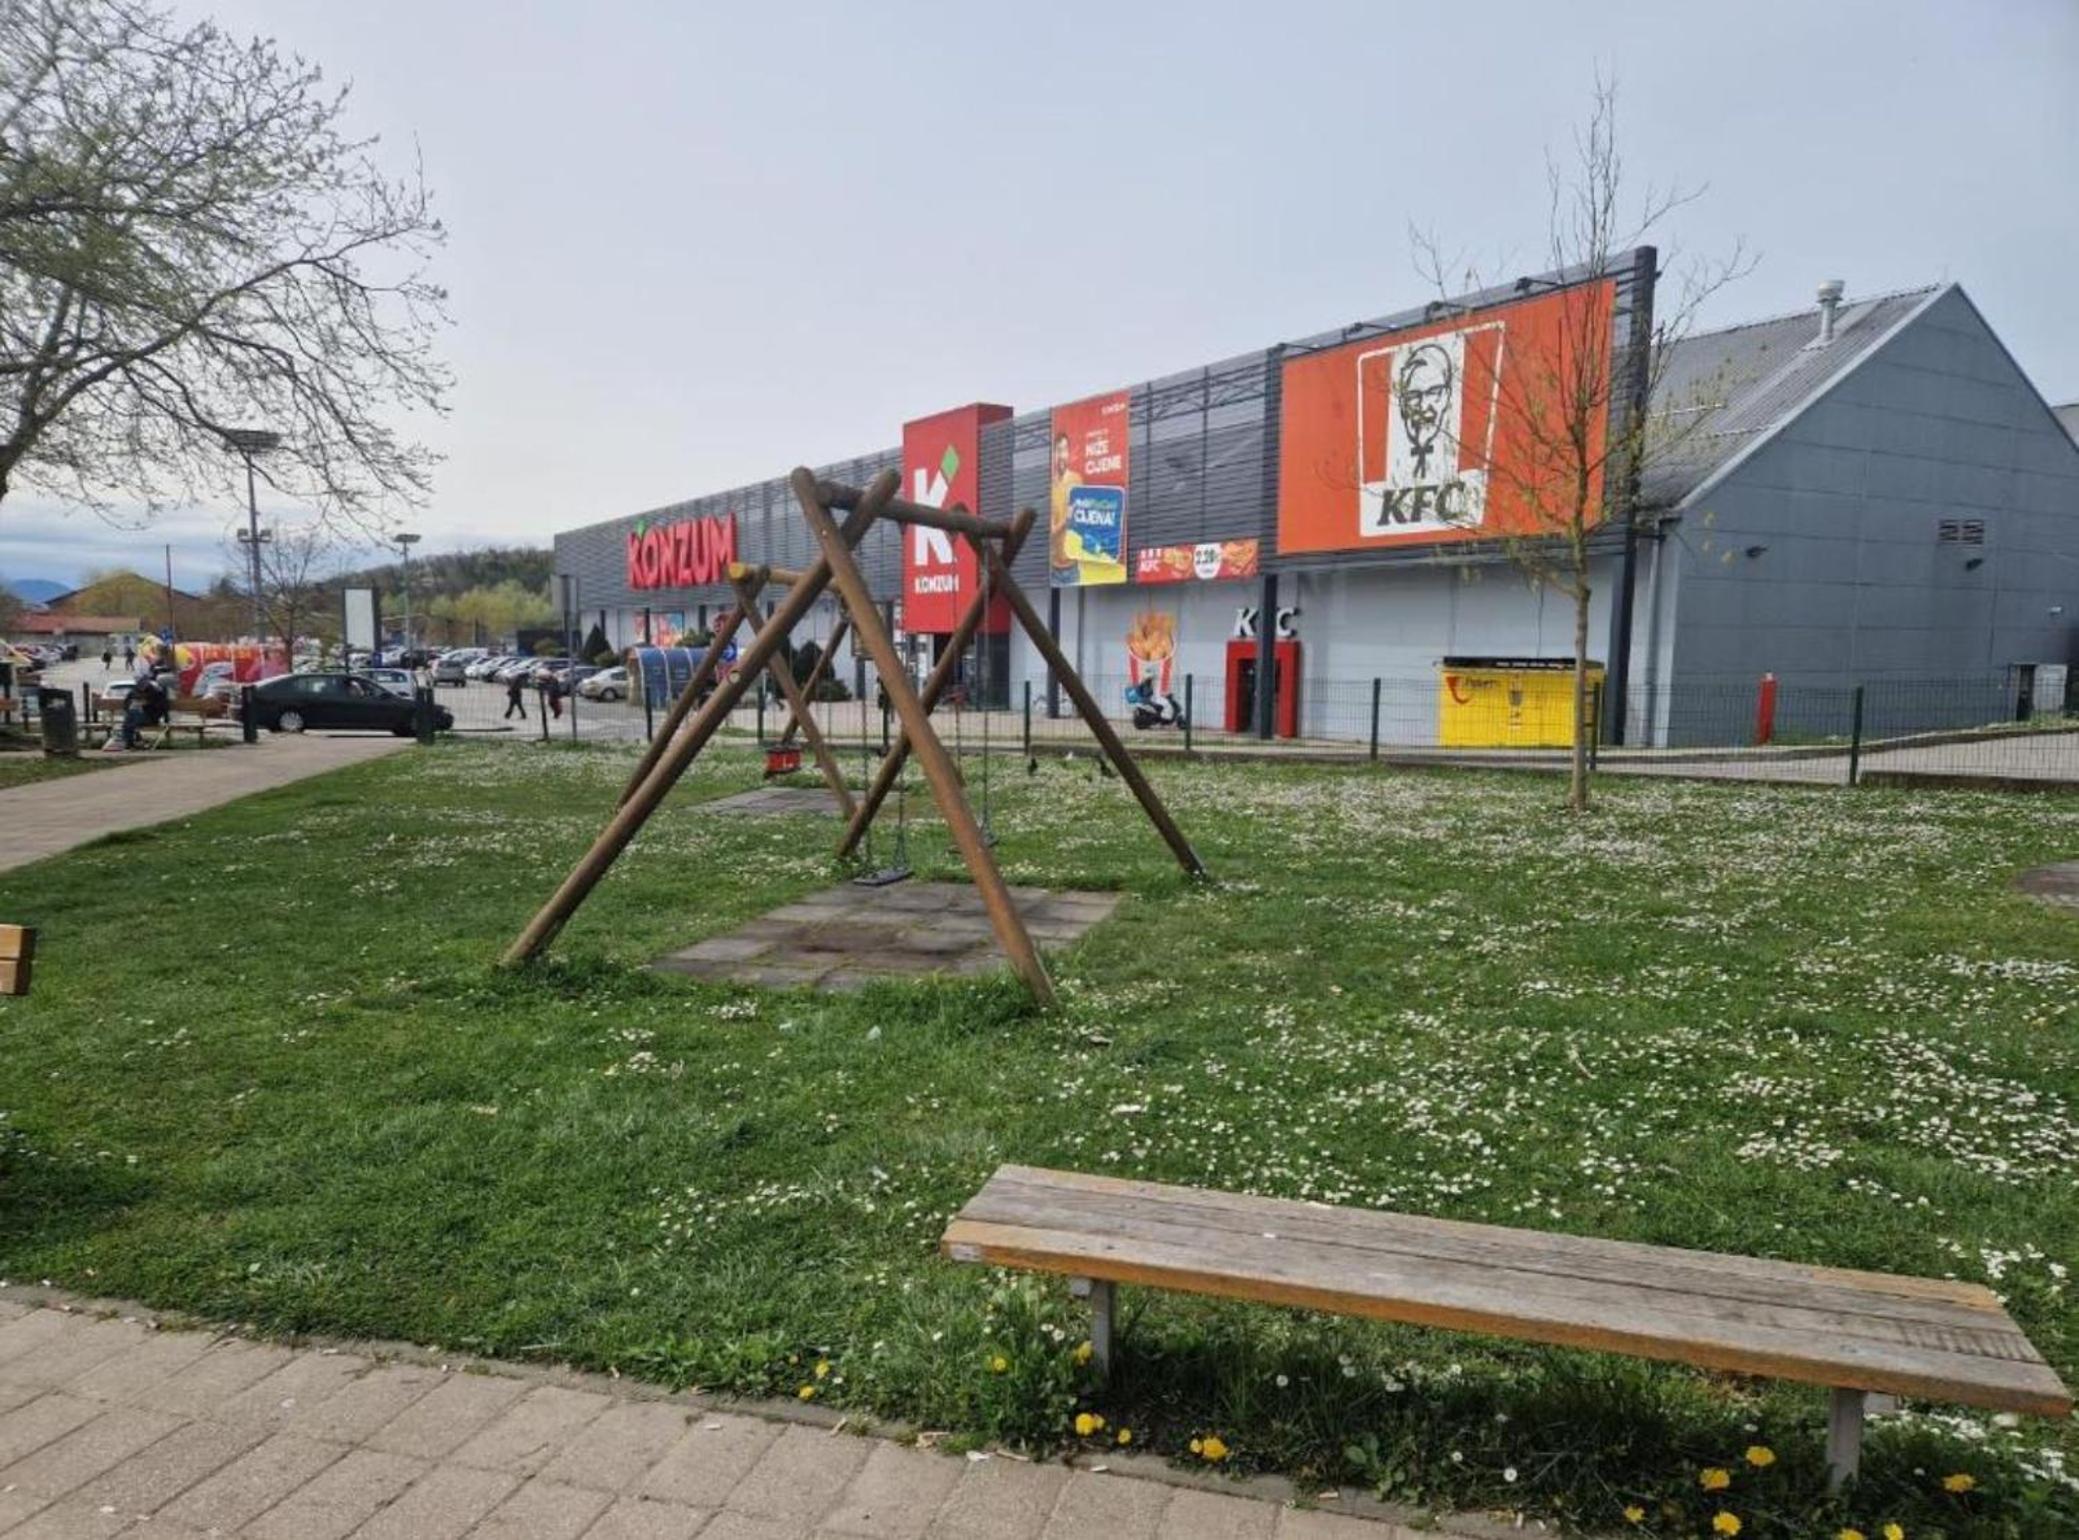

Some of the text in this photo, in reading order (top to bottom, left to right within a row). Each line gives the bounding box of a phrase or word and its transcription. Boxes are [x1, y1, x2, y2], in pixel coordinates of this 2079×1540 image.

[1376, 480, 1466, 526] KFC
[627, 511, 738, 591] KONZUM
[1233, 606, 1298, 637] KC
